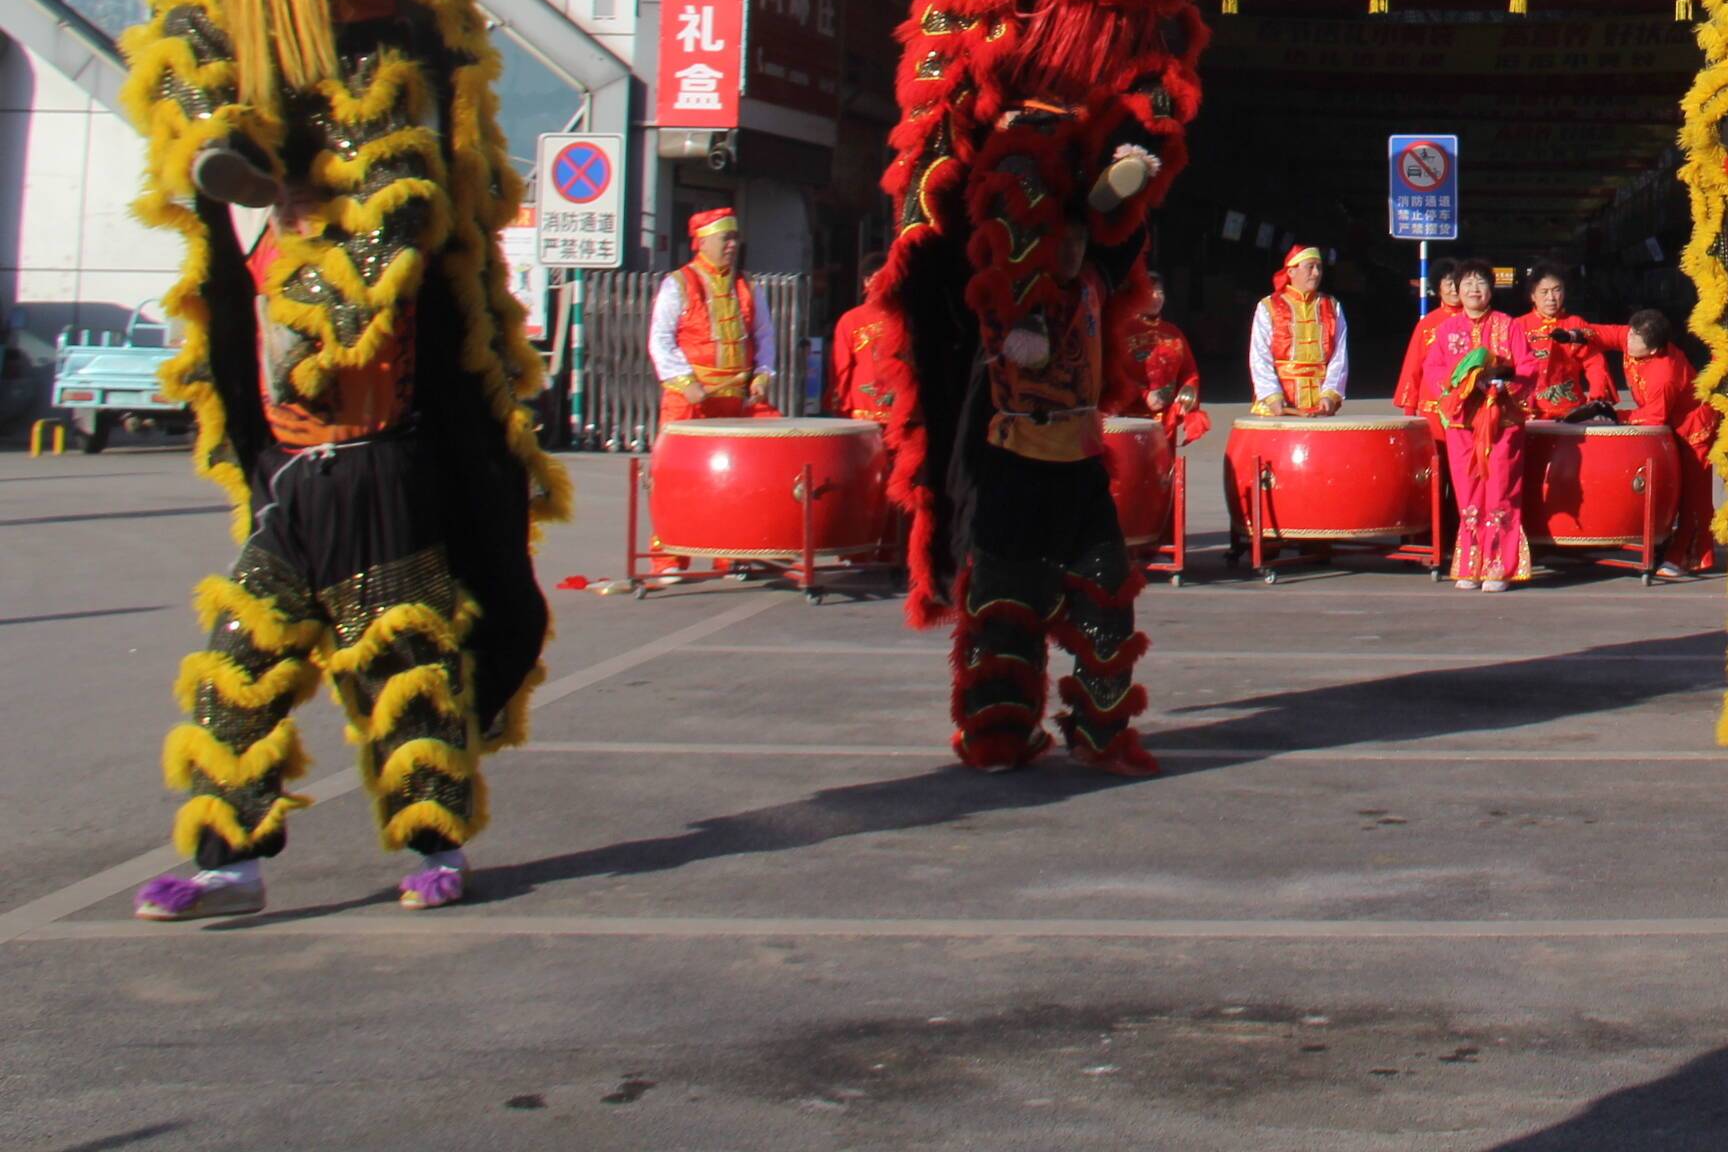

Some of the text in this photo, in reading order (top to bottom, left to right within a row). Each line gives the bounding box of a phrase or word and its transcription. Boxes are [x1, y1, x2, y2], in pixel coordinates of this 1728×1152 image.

[1398, 195, 1451, 207] 消防通道
[543, 212, 616, 233] 消防通道
[1398, 209, 1451, 221] 禁止停车
[543, 238, 615, 259] 严禁停车
